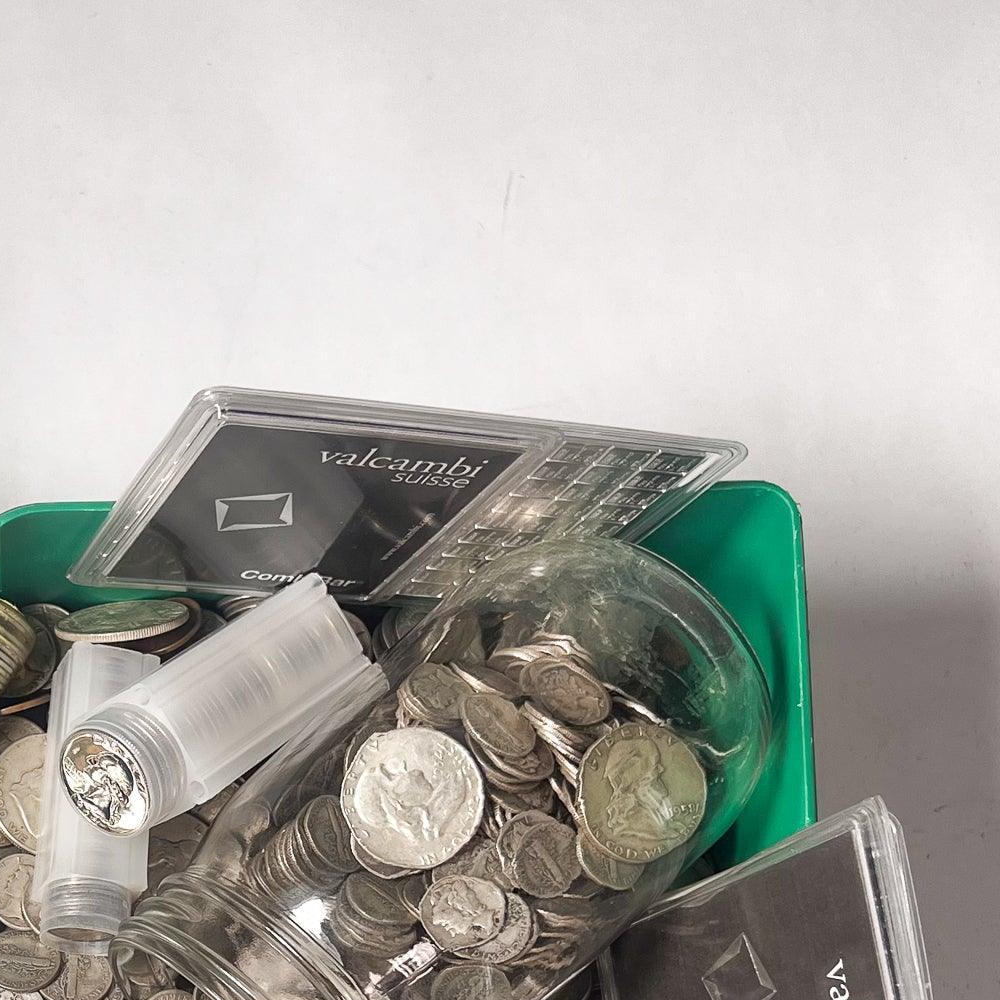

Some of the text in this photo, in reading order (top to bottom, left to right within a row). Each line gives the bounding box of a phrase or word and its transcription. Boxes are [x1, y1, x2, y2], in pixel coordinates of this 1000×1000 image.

[320, 447, 489, 478] valcambi
[390, 472, 470, 489] suisse
[240, 570, 356, 588] ComBar
[606, 840, 638, 859] GOD
